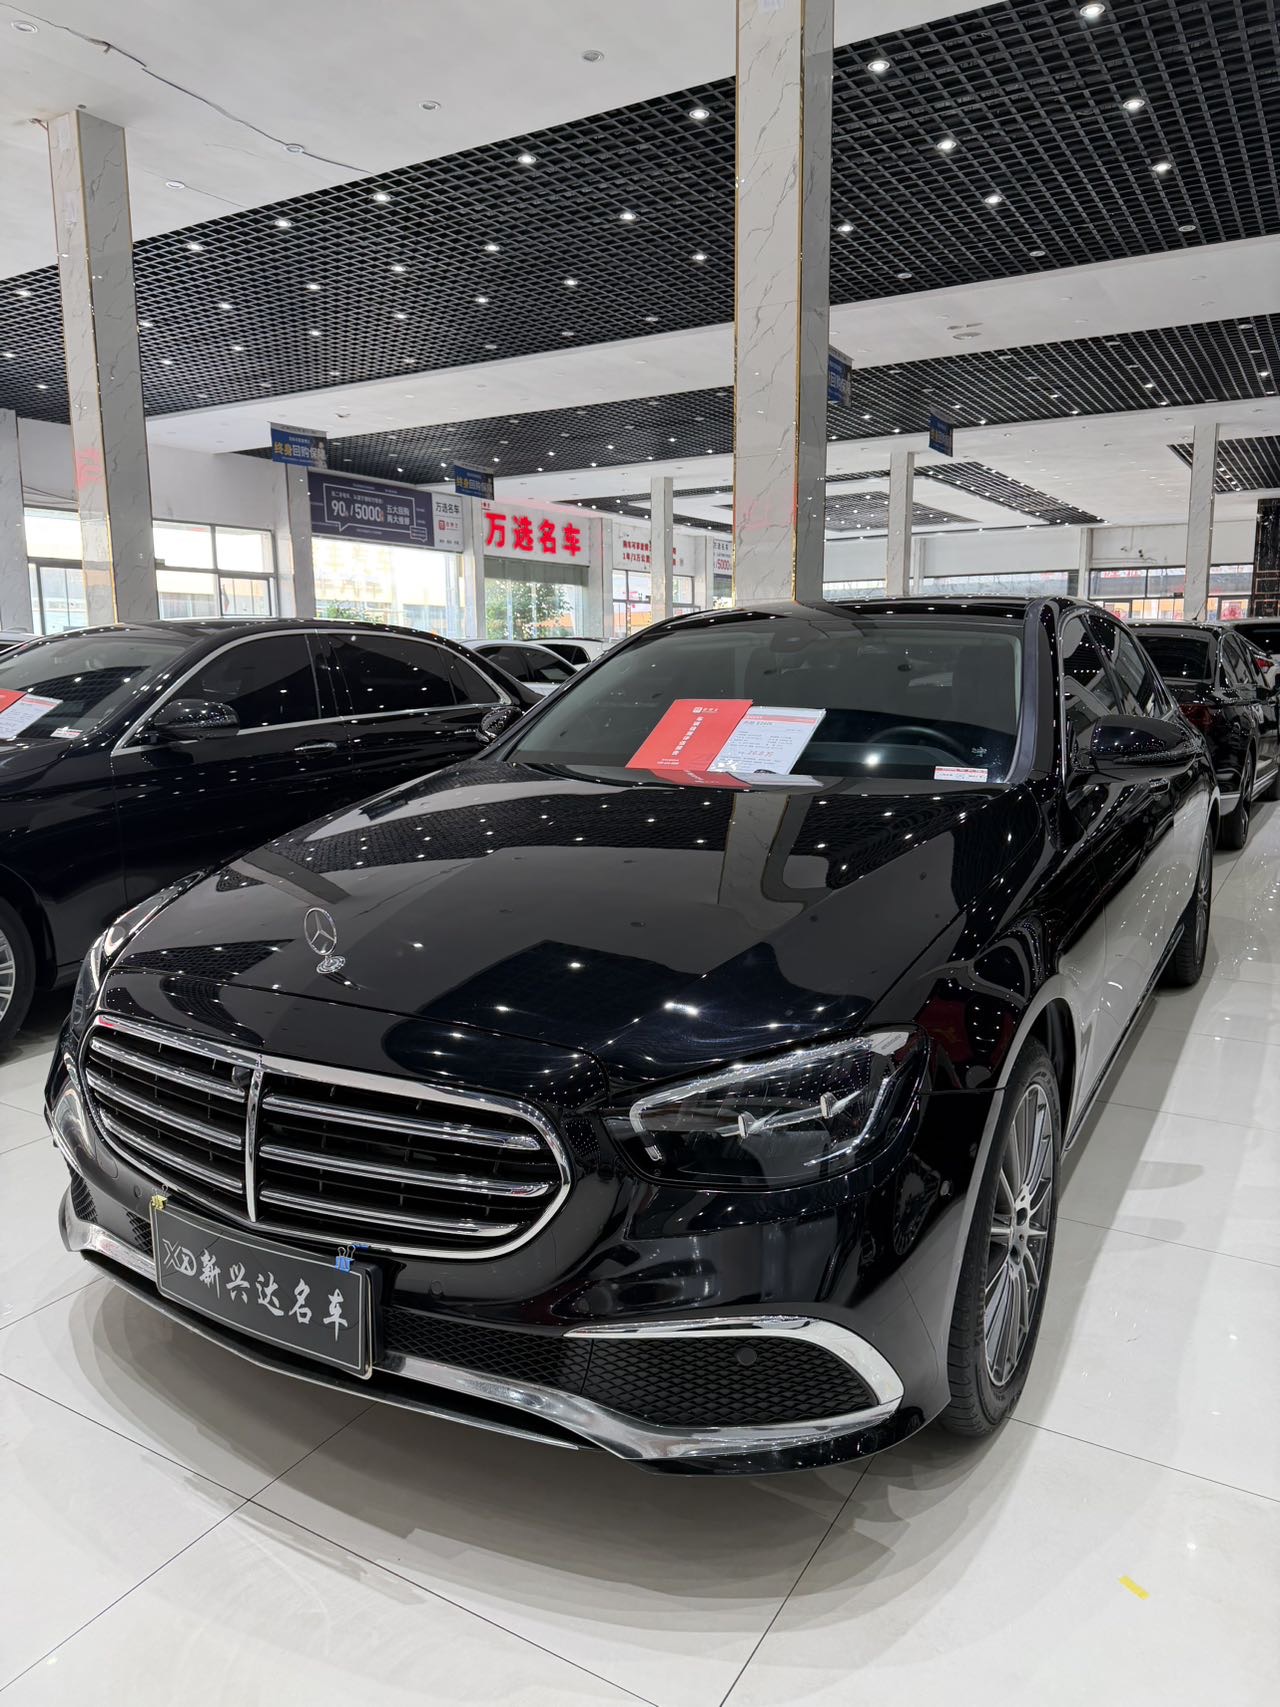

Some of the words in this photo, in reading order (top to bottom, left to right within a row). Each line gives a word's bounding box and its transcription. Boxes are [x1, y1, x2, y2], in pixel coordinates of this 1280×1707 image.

[485, 512, 582, 557] 万选名车
[199, 1248, 348, 1342] 新兴达名车
